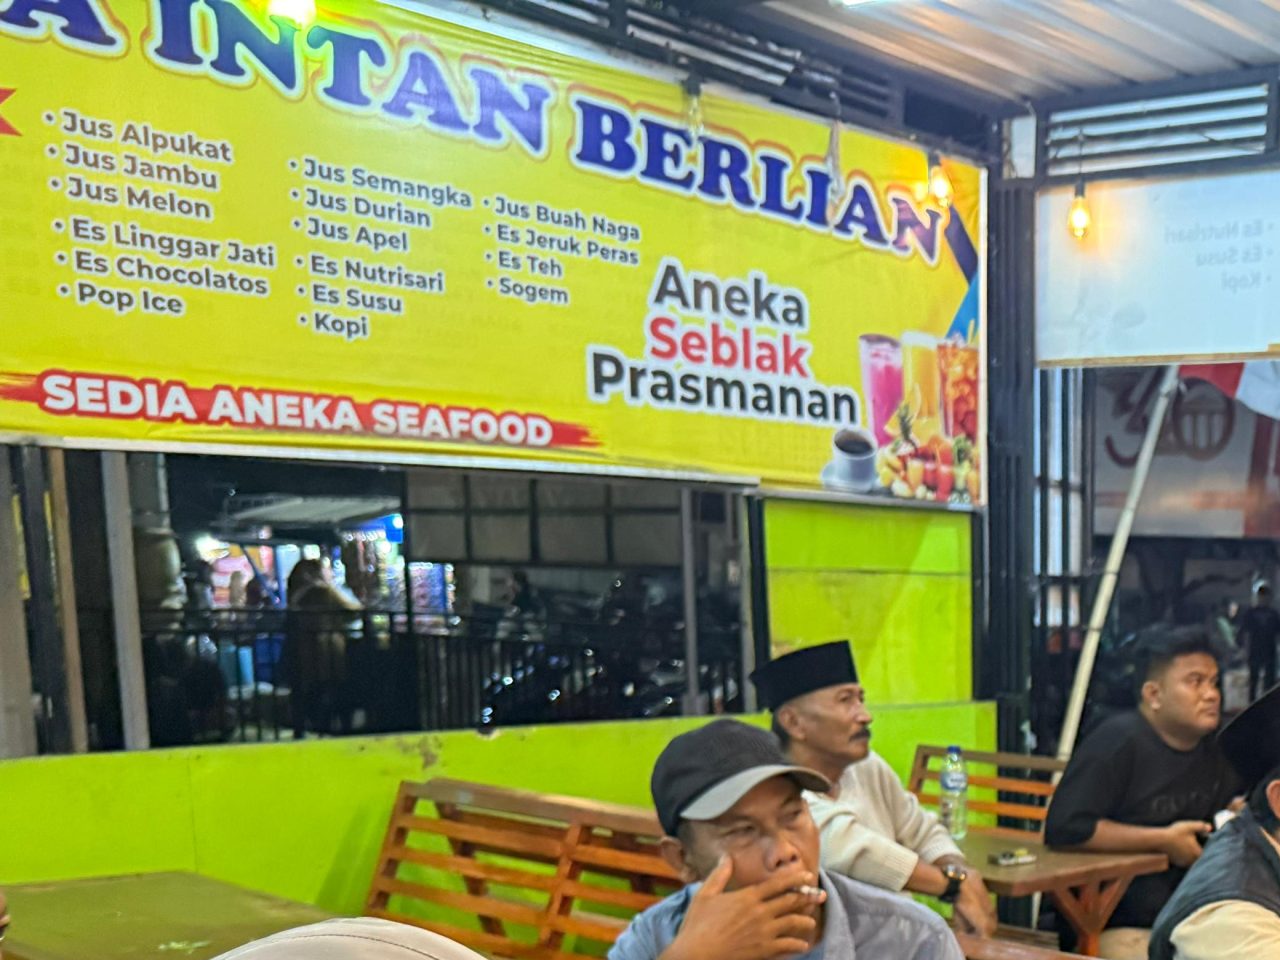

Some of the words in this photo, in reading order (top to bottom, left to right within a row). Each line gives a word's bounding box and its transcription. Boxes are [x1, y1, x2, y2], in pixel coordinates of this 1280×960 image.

[63, 111, 113, 139] Jus
[121, 123, 232, 162] Alpukat
[154, 0, 550, 152] INTAN
[574, 99, 943, 263] BERLIAN
[66, 143, 116, 171] Jus
[124, 154, 218, 189] Jambu
[305, 159, 344, 184] Jus
[352, 168, 472, 208] Semangka
[68, 176, 118, 204] Jus
[127, 185, 212, 219] Melon
[307, 189, 347, 213] Jus
[354, 197, 431, 228] Durian
[73, 219, 106, 244] Es
[114, 225, 220, 263] Linggar
[227, 242, 276, 267] Jati
[308, 219, 349, 243] Jus
[356, 226, 409, 252] Apel
[495, 198, 530, 217] Jus
[538, 204, 585, 231] Buah
[592, 216, 641, 243] Naga
[497, 225, 520, 242] Es
[526, 229, 581, 254] Jeruk
[588, 241, 639, 265] Peras
[499, 251, 522, 270] Es
[527, 257, 563, 278] Teh
[76, 250, 108, 276] Es
[117, 256, 268, 295] Chocolatos
[311, 255, 338, 276] Es
[345, 260, 444, 292] Nutrisari
[500, 278, 569, 304] Sogem
[655, 263, 805, 327] Aneka
[79, 283, 134, 315] Pop
[143, 292, 183, 314] Ice
[314, 284, 339, 305] Es
[347, 291, 402, 313] Susu
[315, 312, 368, 338] Kopi
[649, 316, 809, 378] Seblak
[592, 351, 858, 423] Prasmanan
[43, 376, 197, 420] SEDIA
[209, 390, 362, 432] ANEKA
[372, 404, 553, 447] SEAFOOD
